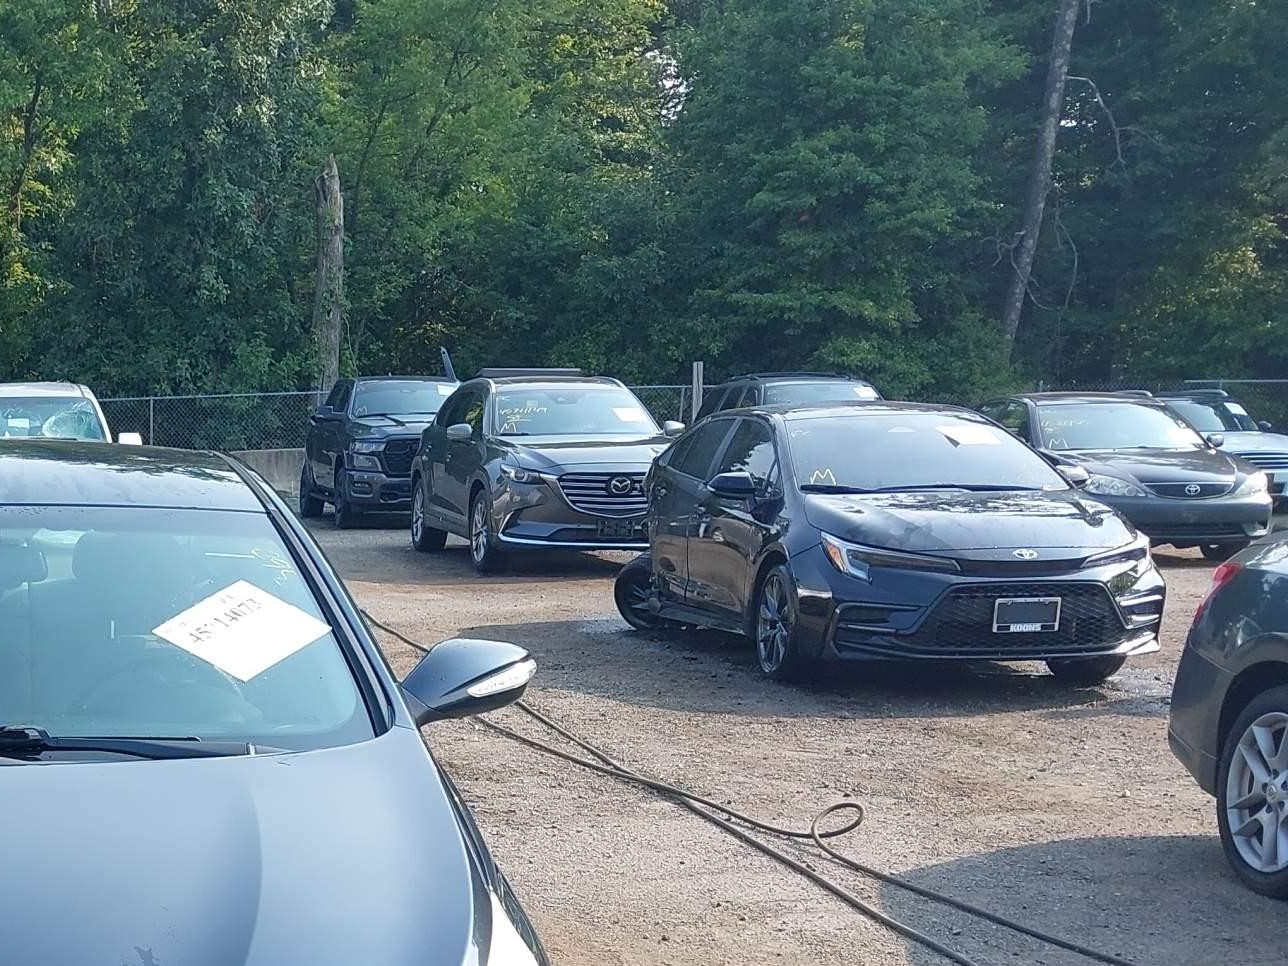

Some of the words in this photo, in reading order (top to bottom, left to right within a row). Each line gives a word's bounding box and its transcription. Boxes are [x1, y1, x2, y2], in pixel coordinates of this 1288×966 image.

[501, 422, 517, 433] M
[809, 468, 837, 486] M
[1009, 623, 1042, 632] KOONS
